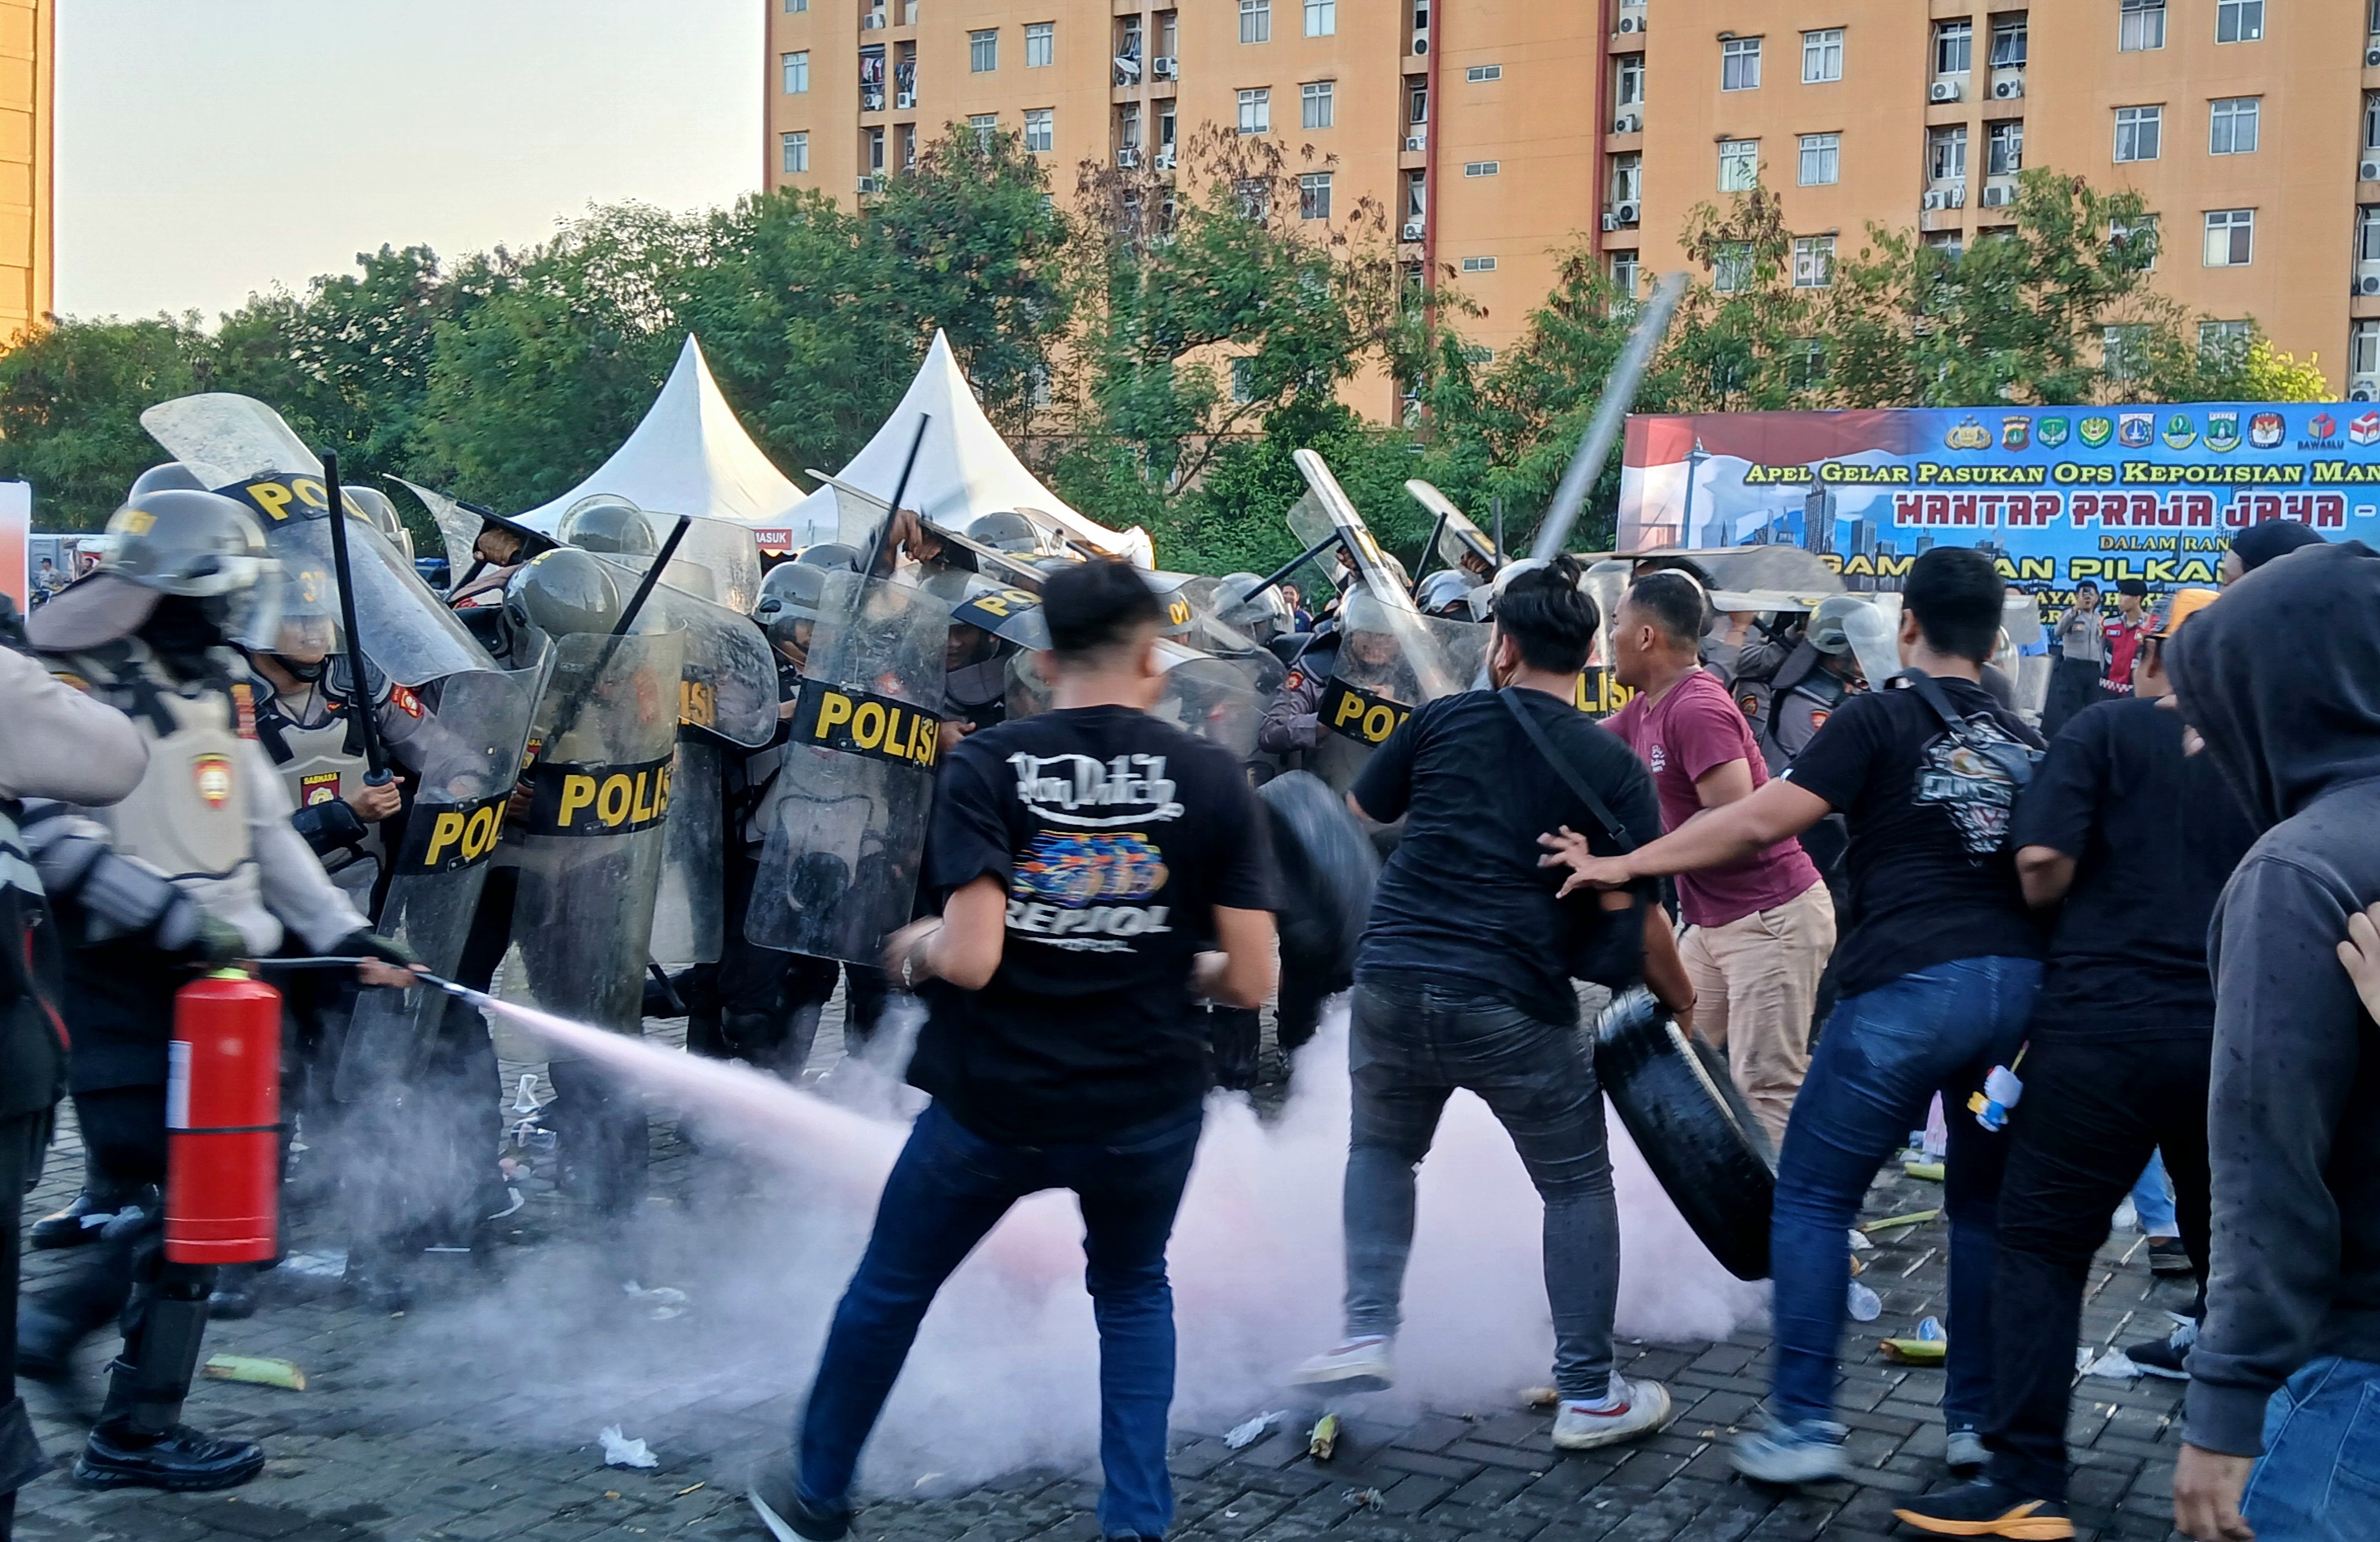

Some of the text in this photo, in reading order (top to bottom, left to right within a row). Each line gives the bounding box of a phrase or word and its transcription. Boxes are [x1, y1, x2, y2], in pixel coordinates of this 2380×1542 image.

[1747, 464, 1812, 482] APEL
[1821, 463, 1909, 482] GELAR
[1918, 463, 2043, 482] PASUKAN
[2054, 463, 2113, 482] OPS
[2123, 462, 2303, 482] KEPOLISIAN
[1895, 494, 2060, 525] MANTAP
[2072, 494, 2211, 526] PRAJA
[2225, 495, 2344, 527] JAYA
[2099, 536, 2230, 551] DALAM RAN
[2070, 559, 2227, 582] PILKA
[679, 680, 716, 727] ISI
[1576, 672, 1634, 711] LISI
[815, 691, 940, 766] POLISI
